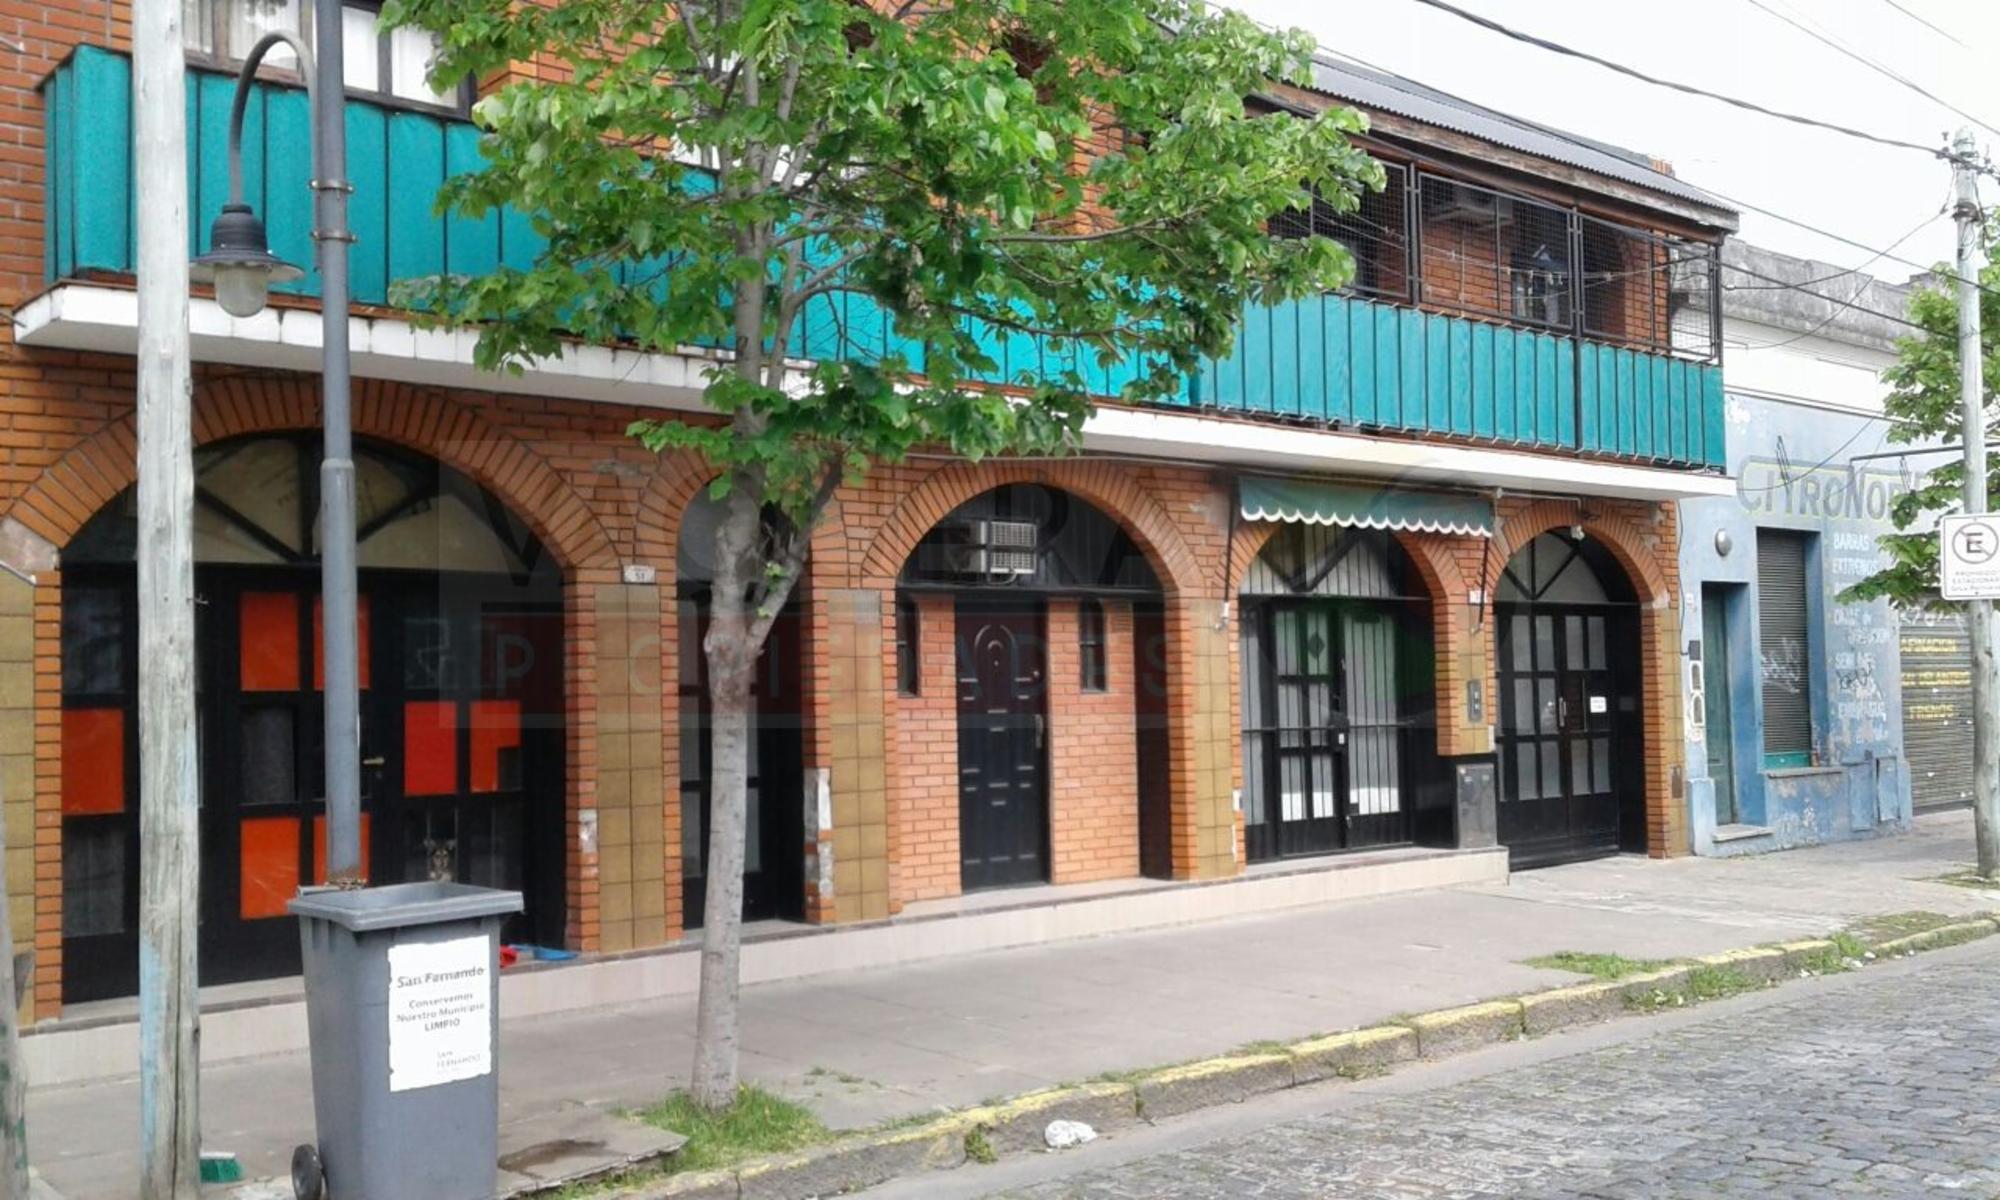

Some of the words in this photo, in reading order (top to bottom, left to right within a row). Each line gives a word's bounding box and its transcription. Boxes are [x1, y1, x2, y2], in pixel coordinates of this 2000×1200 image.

[397, 975, 423, 989] San
[425, 966, 485, 984] Fernando
[409, 992, 473, 1009] Conservemos
[396, 1010, 437, 1024] Nuestro
[424, 1017, 461, 1032] LIMPIO
